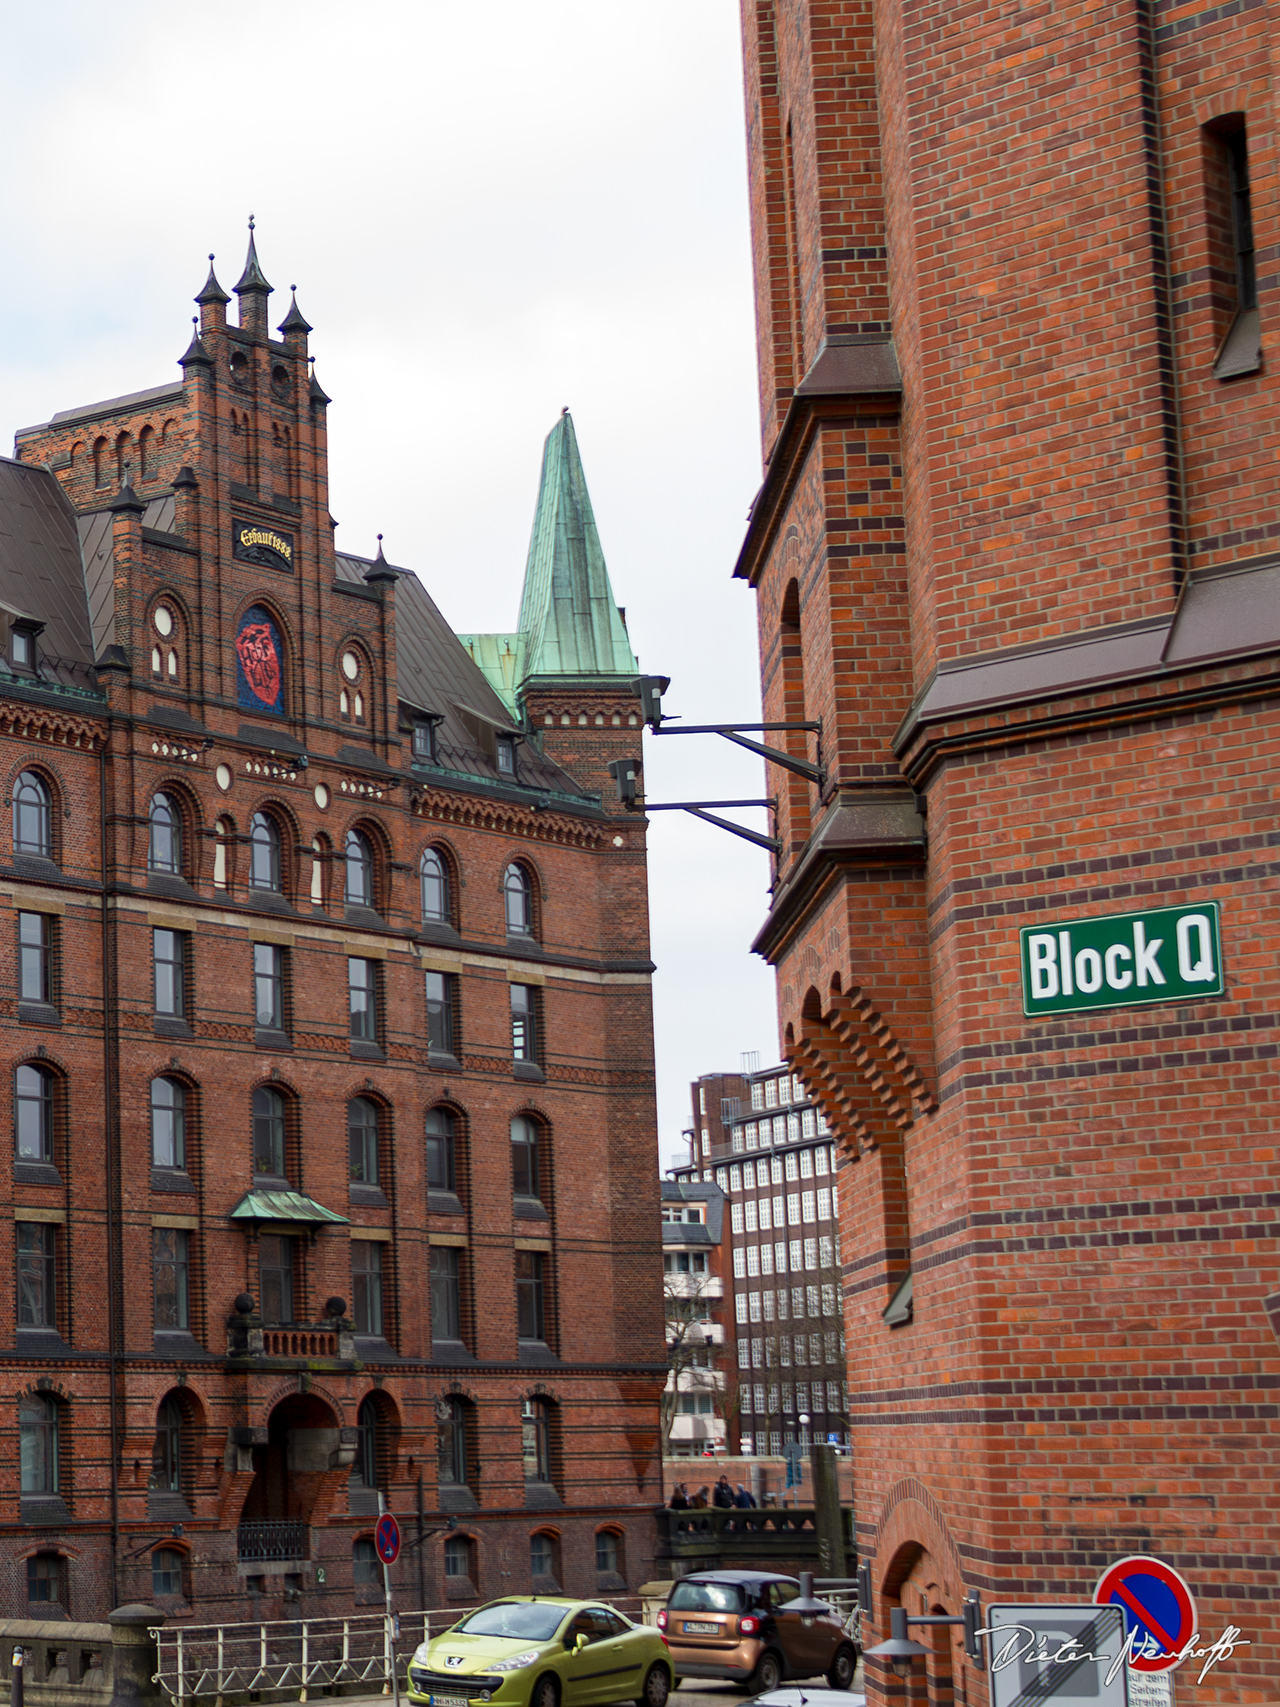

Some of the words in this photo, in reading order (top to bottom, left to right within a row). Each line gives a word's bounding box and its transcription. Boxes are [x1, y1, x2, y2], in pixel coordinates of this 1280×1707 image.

[1028, 920, 1167, 1000] Block
[1175, 913, 1218, 983] Q
[317, 1567, 325, 1582] 2
